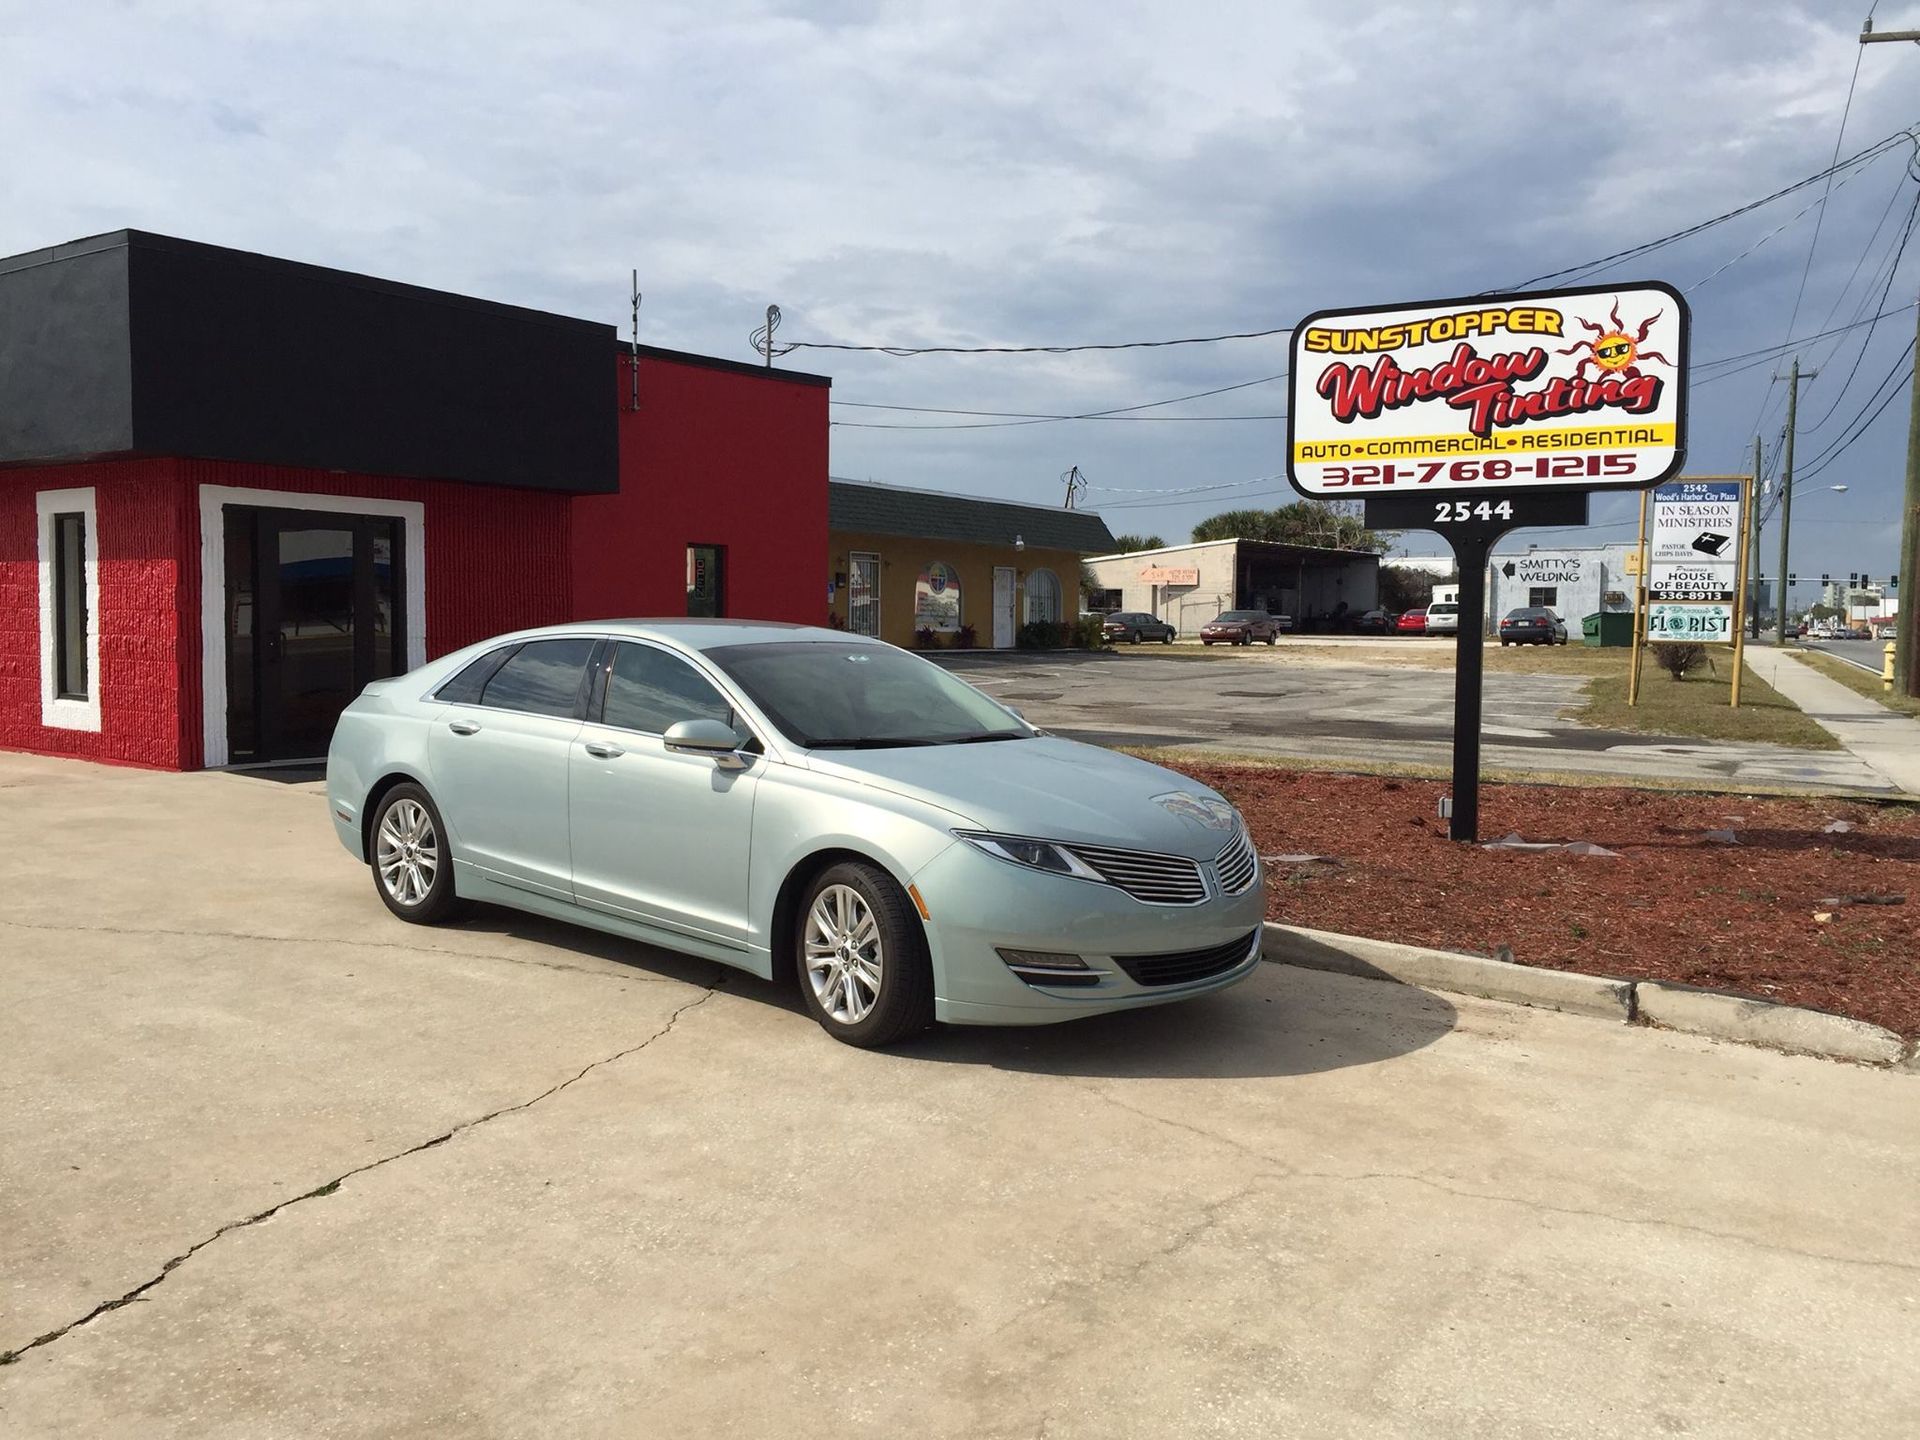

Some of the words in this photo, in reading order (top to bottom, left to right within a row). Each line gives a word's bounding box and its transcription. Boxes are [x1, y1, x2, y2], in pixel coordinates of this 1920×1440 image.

[1305, 307, 1564, 354] SUNSTOPPER
[1316, 343, 1548, 423] Window
[1446, 374, 1664, 438] Tinting
[1301, 443, 1351, 458] AUTO
[1366, 437, 1507, 456] COMMERCIAL
[1522, 429, 1663, 449] RESIDENTIAL
[1322, 454, 1638, 487] 321-768-1215
[1683, 484, 1708, 492] 2542
[1681, 493, 1703, 501] Harbor
[1705, 493, 1719, 502] City
[1720, 493, 1737, 501] Plaza
[1434, 500, 1514, 523] 2544
[1662, 506, 1675, 515] IN
[1678, 505, 1730, 515] SEASON
[1658, 518, 1733, 528] MINISTRIES
[1519, 558, 1581, 570] SMITTY'S
[1519, 571, 1581, 582] WELDING
[1668, 572, 1715, 581] HOUSE
[1654, 581, 1672, 589] OF
[1675, 581, 1728, 590] BEAUTY
[1659, 591, 1722, 600] 536-8913
